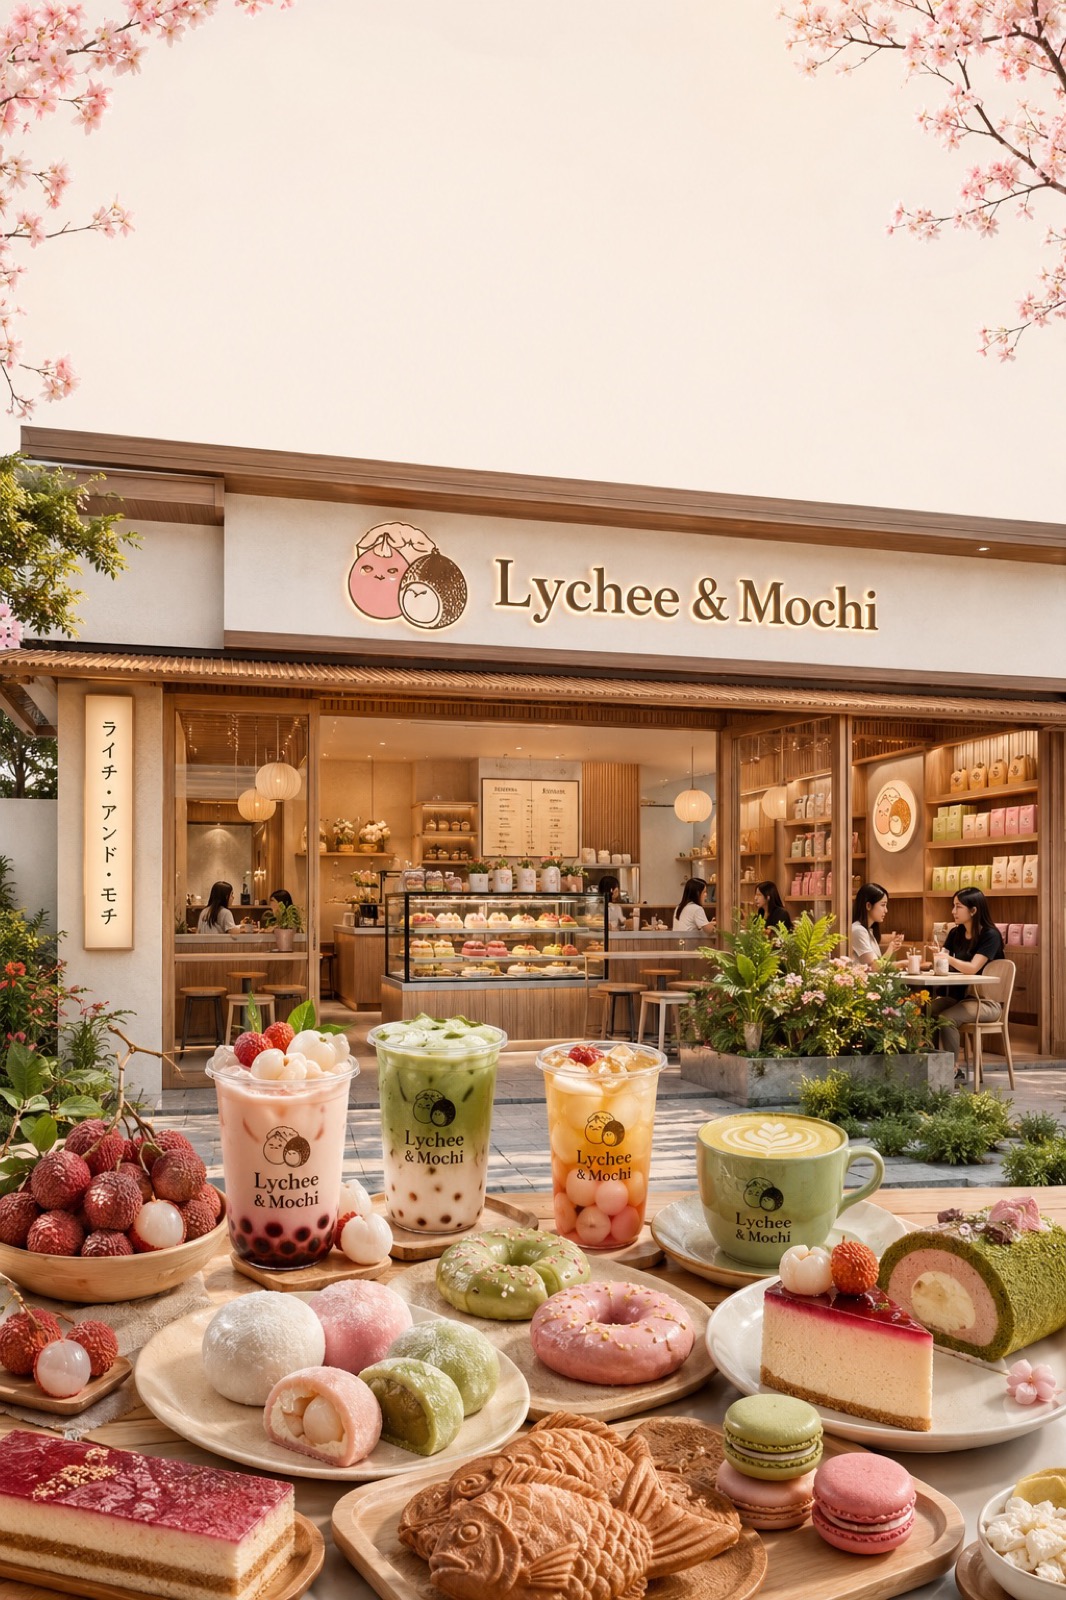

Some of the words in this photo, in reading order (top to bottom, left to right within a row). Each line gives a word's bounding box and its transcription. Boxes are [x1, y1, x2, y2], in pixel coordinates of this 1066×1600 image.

[493, 558, 681, 623] Lychee
[691, 576, 729, 621] &
[738, 578, 879, 631] Mochi
[101, 720, 118, 925] ライチ・アンド・モチ
[404, 1129, 464, 1150] Lychee
[404, 1149, 414, 1163] &
[417, 1149, 464, 1165] Mochi
[576, 1149, 632, 1169] Lychee
[254, 1171, 319, 1194] Lychee
[576, 1168, 586, 1180] &
[588, 1166, 631, 1182] Mochi
[254, 1193, 266, 1208] &
[268, 1190, 319, 1209] Mochi
[735, 1211, 792, 1230] Lychee
[735, 1228, 745, 1241] &
[748, 1230, 791, 1244] Mochi
